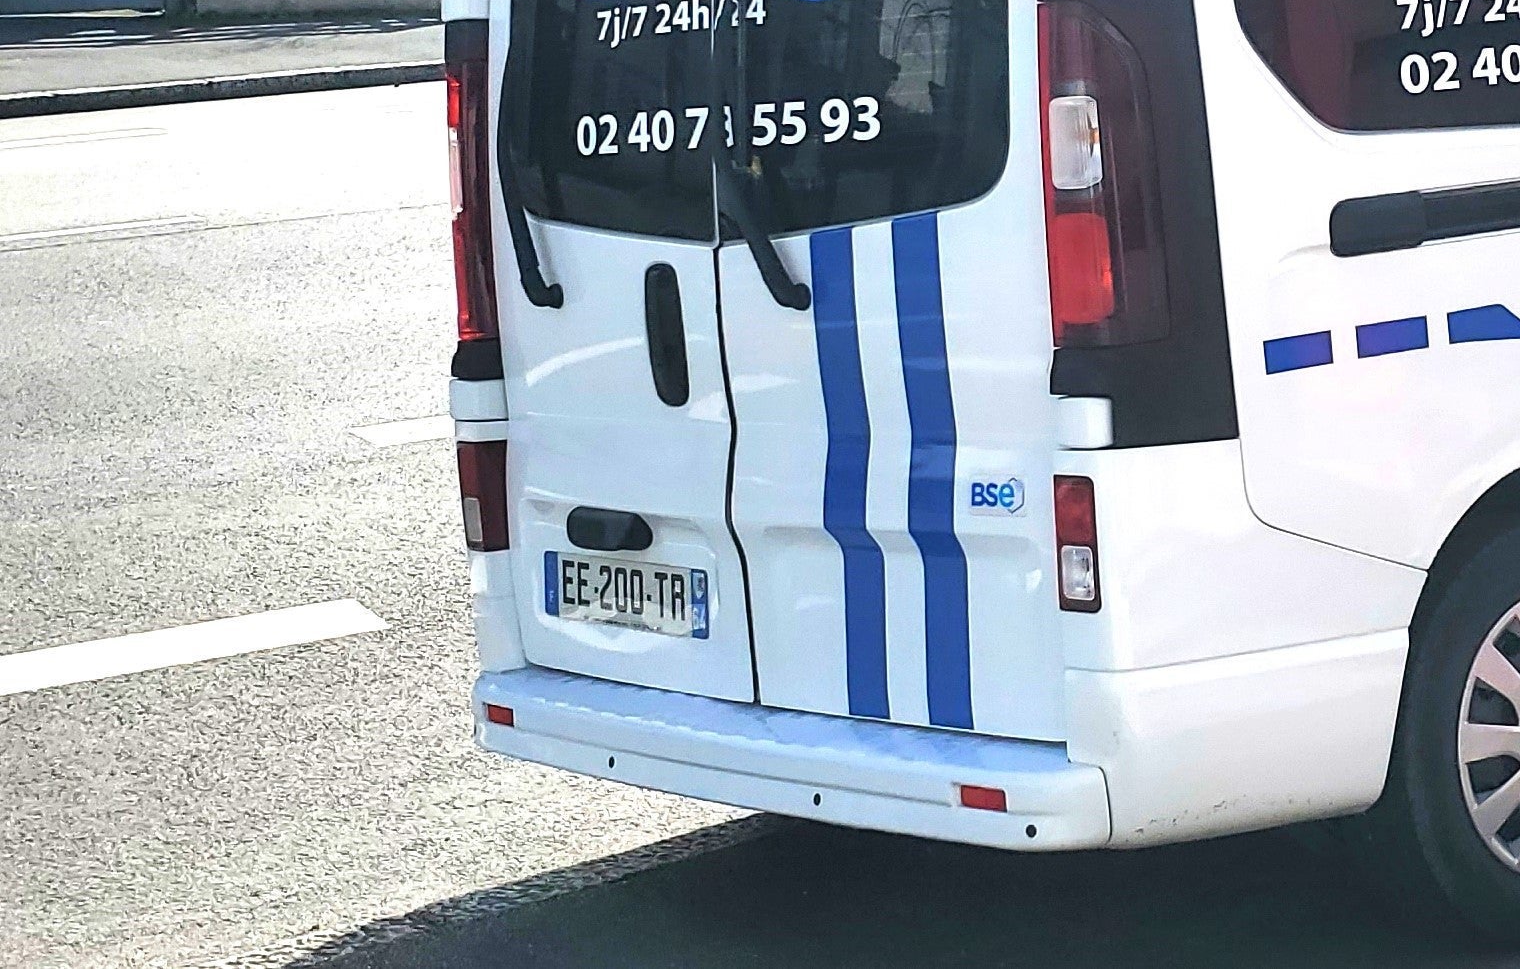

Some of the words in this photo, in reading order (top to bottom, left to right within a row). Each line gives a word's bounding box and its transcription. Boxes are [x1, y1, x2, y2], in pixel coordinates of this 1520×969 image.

[596, 5, 648, 49] 7j/7
[1400, 51, 1461, 94] 02
[576, 113, 619, 156] 02
[627, 109, 675, 152] 40
[751, 100, 807, 147] 55
[819, 96, 881, 143] 93
[562, 559, 686, 622] EE-200-TR
